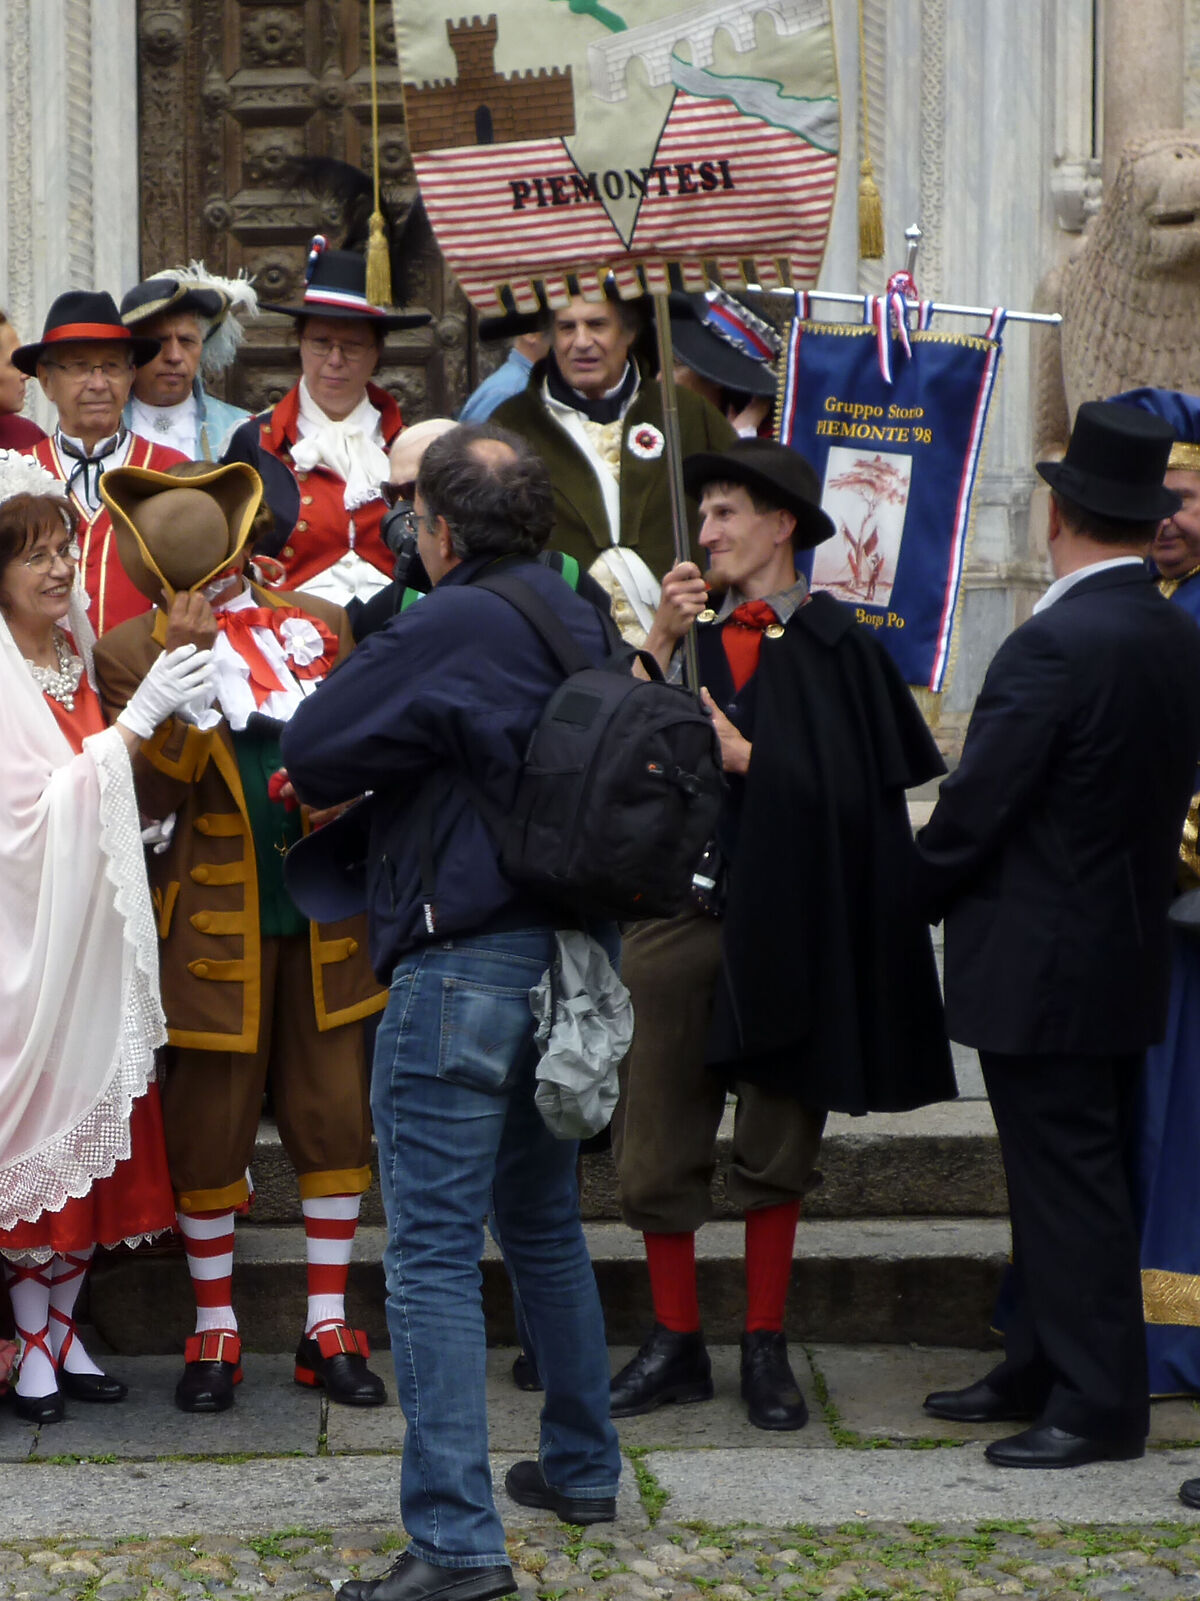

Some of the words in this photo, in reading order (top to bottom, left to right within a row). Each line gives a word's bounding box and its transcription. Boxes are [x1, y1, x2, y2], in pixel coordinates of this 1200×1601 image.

[508, 159, 736, 210] PIEMONTESI
[824, 396, 884, 420] Gruppo
[816, 420, 910, 442] PIEMONTE
[887, 611, 905, 629] Po
